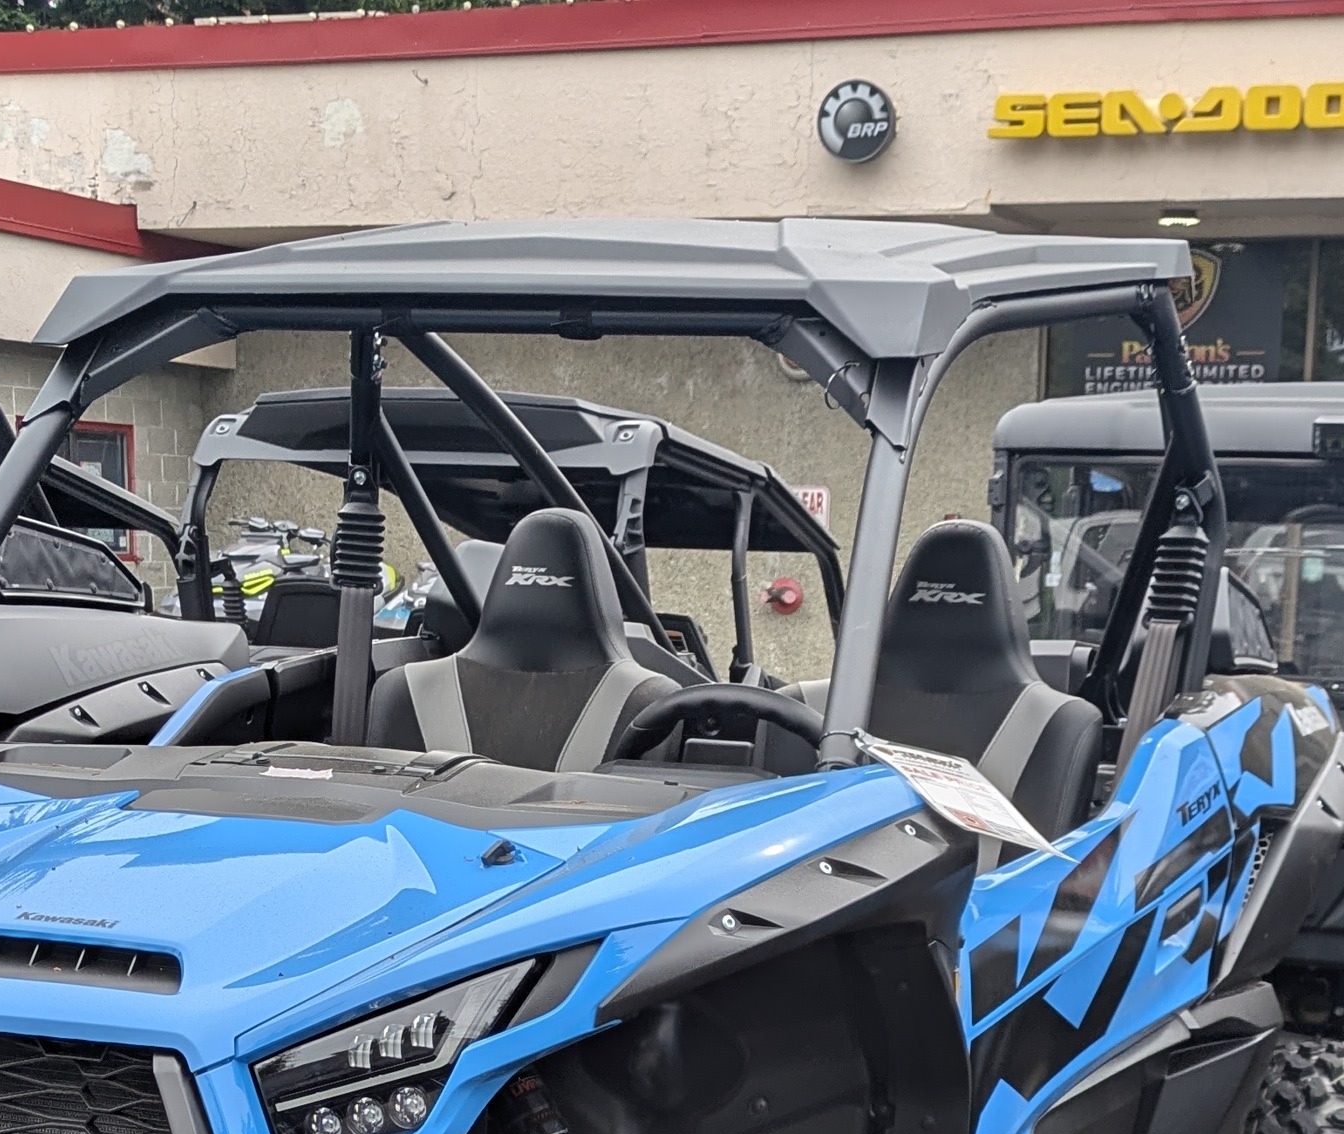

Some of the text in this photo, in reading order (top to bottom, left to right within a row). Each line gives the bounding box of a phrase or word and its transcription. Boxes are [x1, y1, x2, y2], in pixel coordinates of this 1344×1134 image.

[847, 121, 889, 139] BRP
[1085, 364, 1265, 381] LIFETI IMITED
[505, 573, 575, 587] KRX
[908, 589, 986, 605] KRX
[49, 626, 184, 688] Kawasaki
[15, 911, 120, 929] Kawasaki
